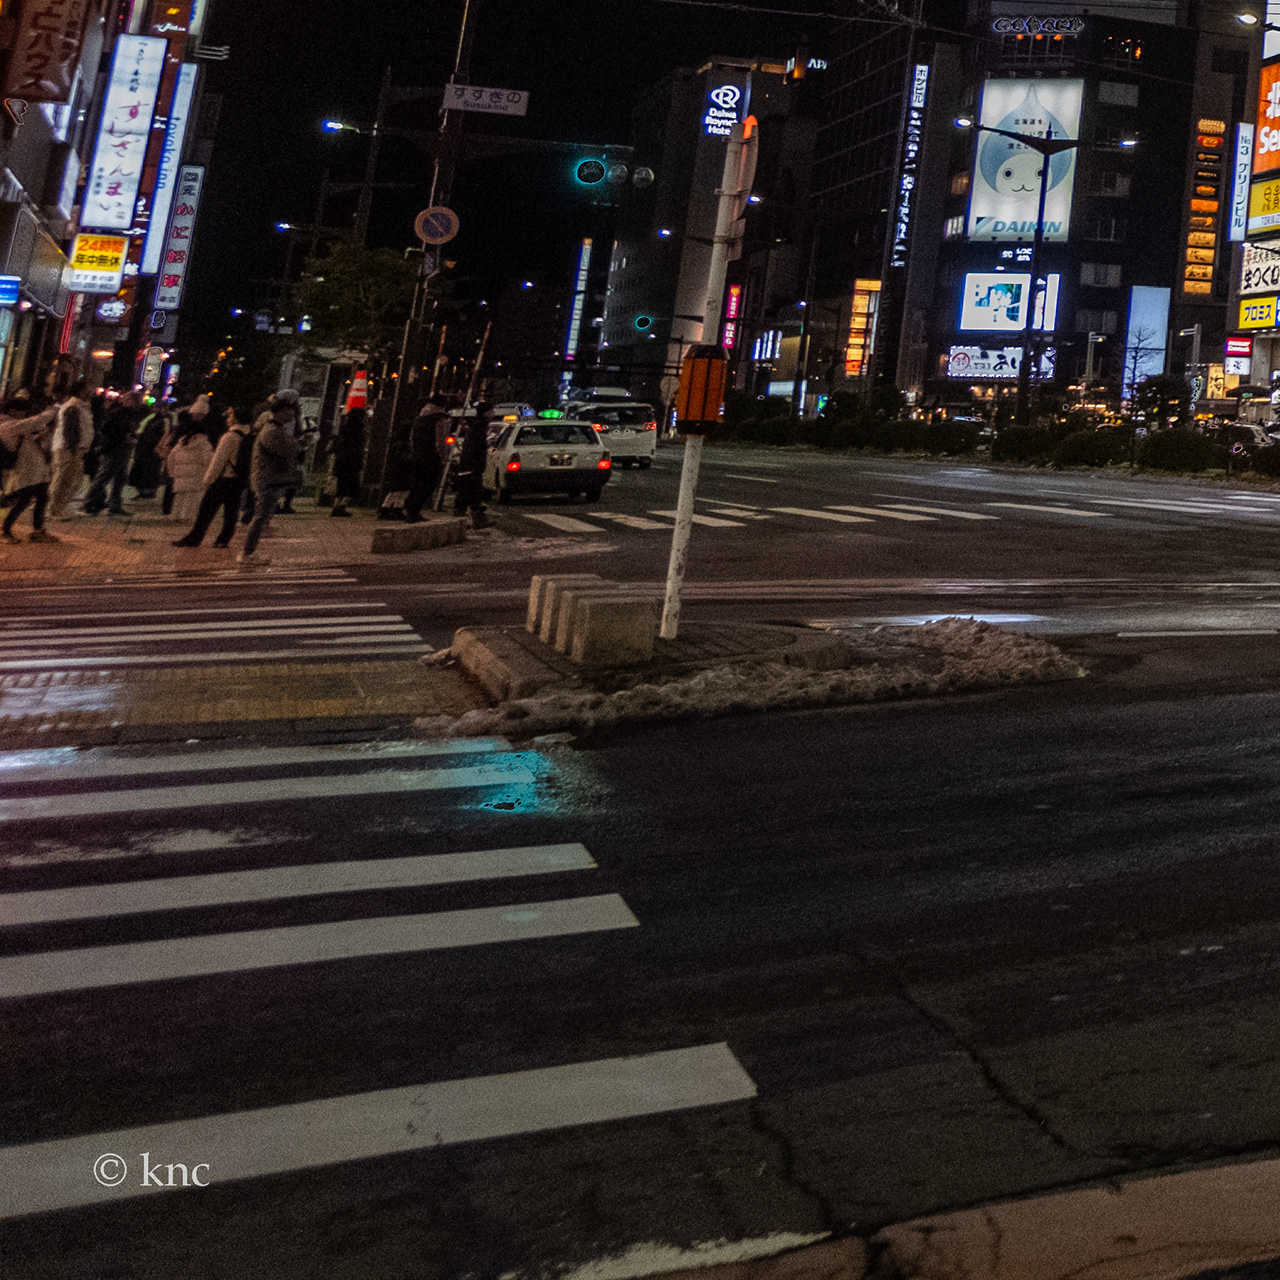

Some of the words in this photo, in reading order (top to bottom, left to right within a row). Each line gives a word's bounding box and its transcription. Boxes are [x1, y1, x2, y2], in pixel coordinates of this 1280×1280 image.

[454, 88, 521, 103] すすきの
[1233, 163, 1249, 228] グリーンビル
[1244, 304, 1272, 321] プロミス
